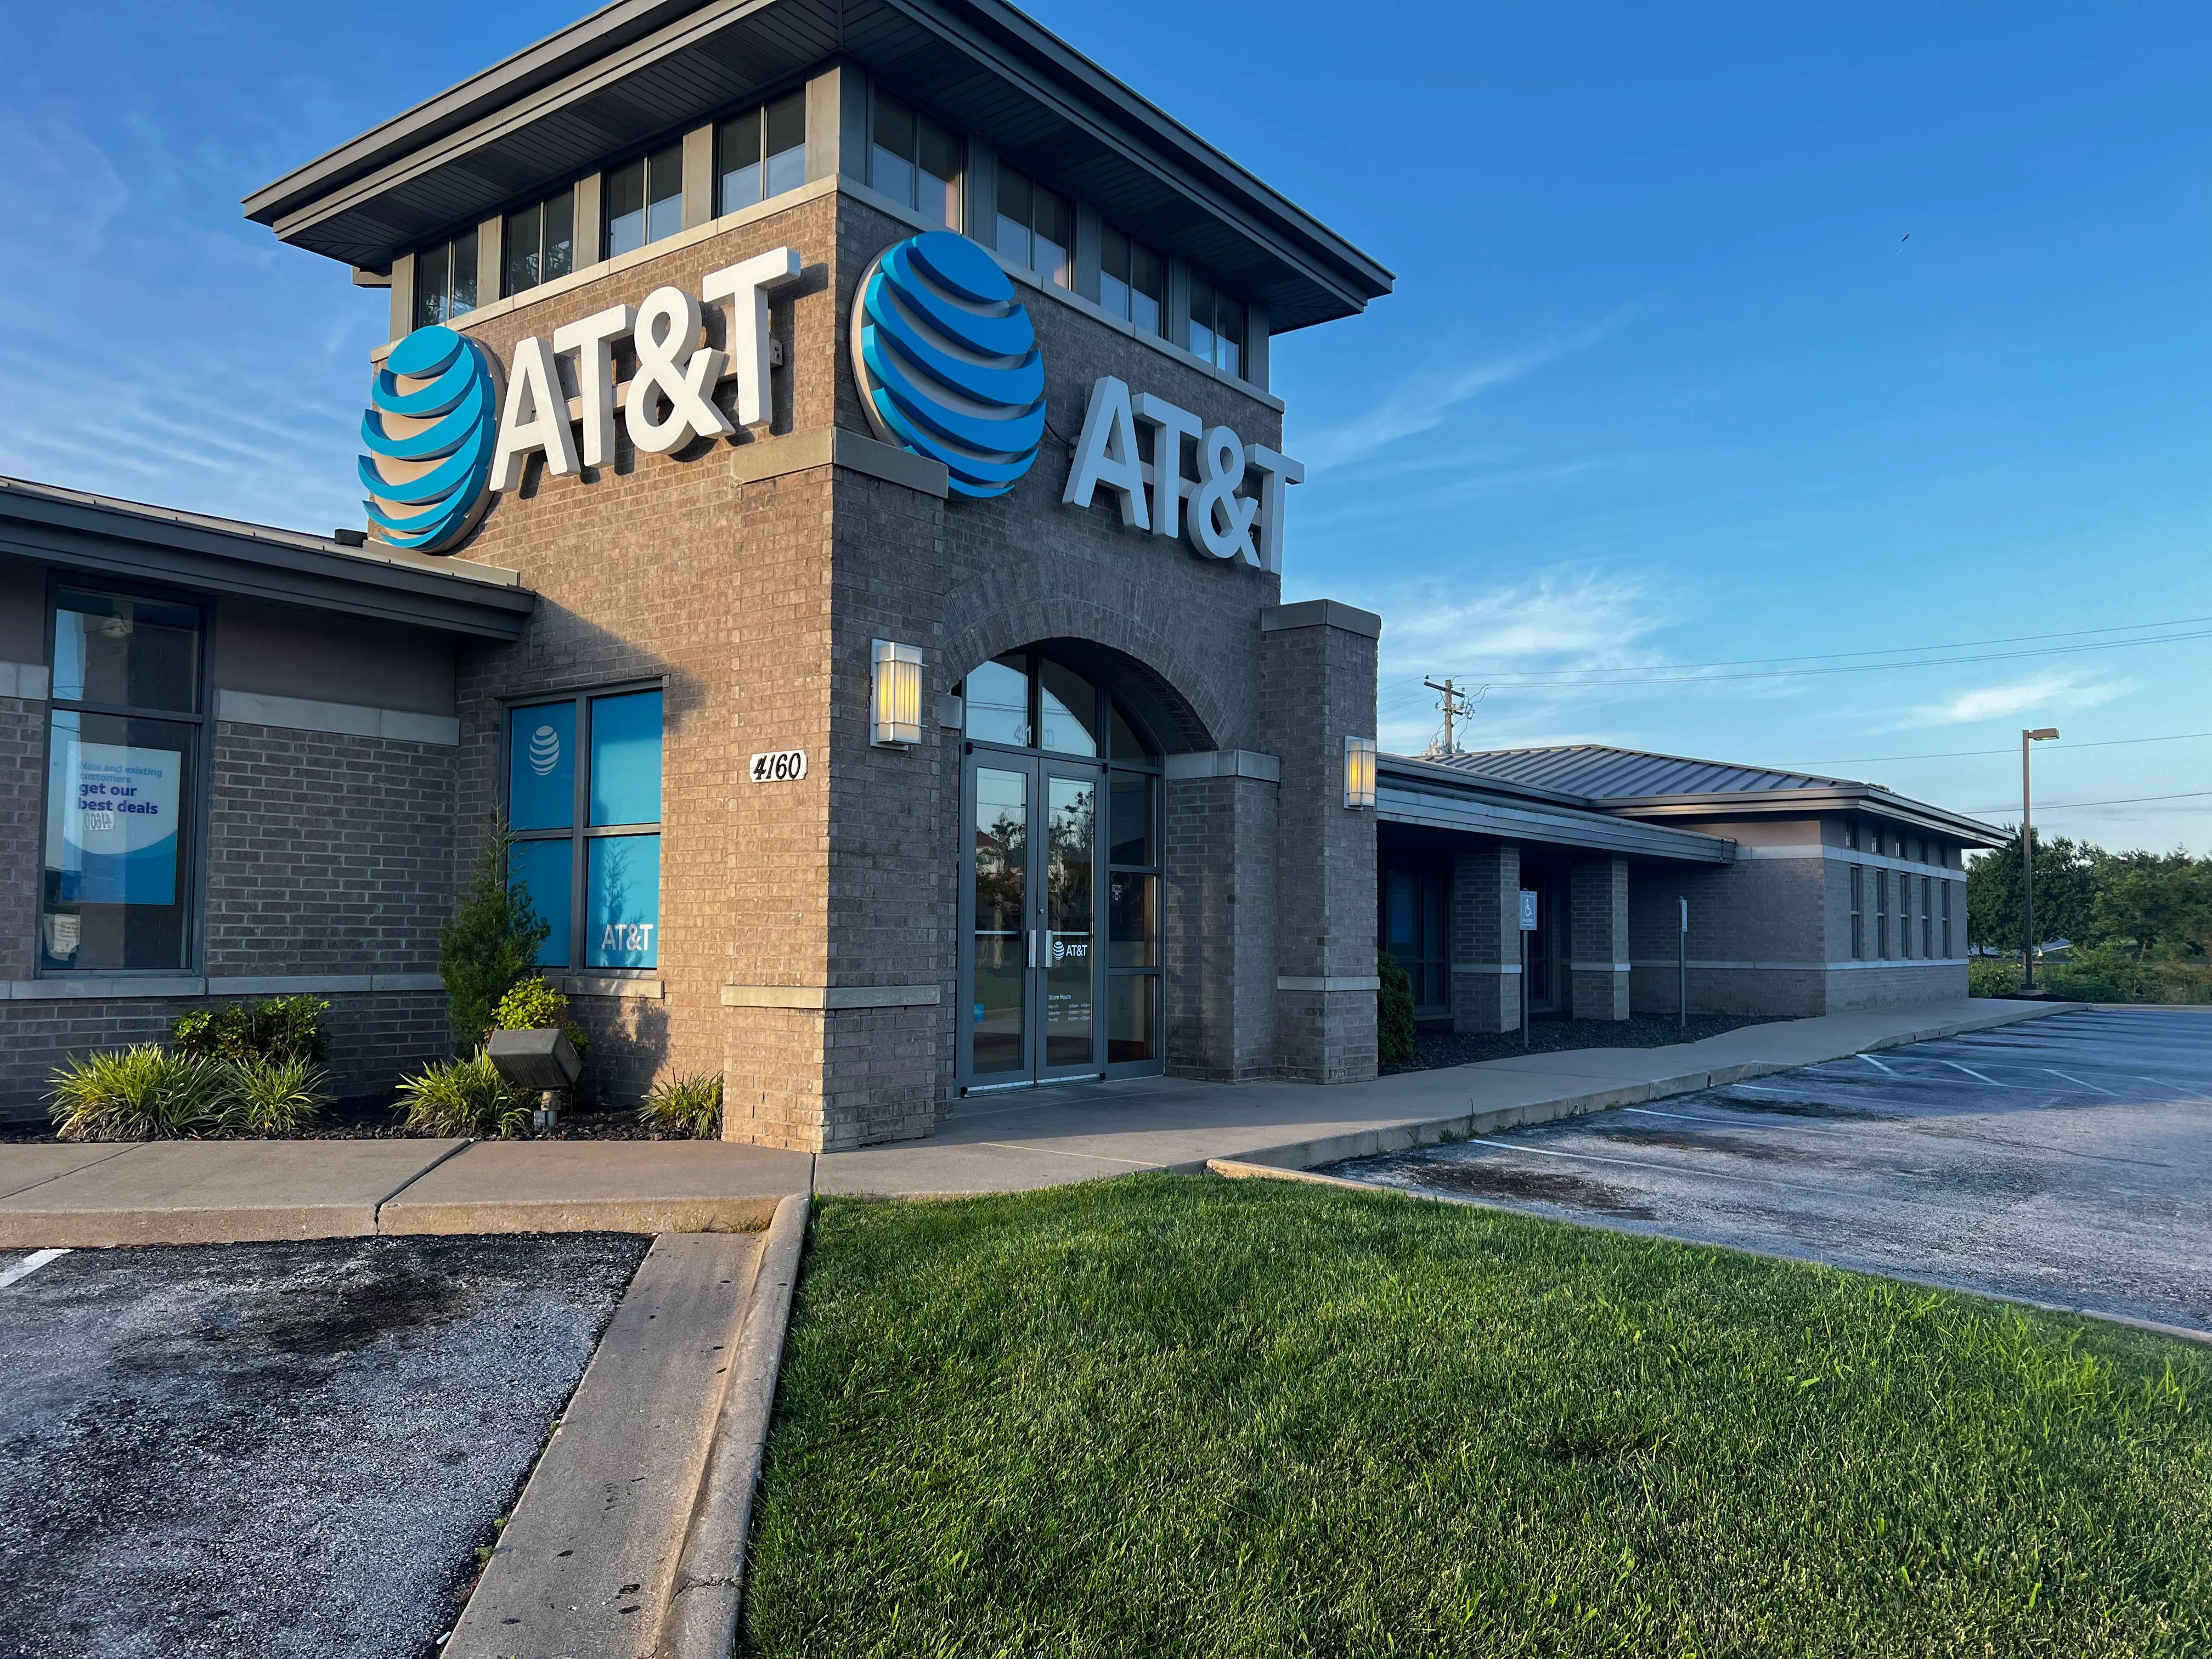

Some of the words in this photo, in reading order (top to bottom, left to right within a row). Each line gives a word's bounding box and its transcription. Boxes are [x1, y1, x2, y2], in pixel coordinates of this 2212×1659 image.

[489, 246, 800, 493] AT&T
[1063, 375, 1305, 575] AT&T
[81, 762, 101, 771] New
[104, 765, 122, 773] and
[125, 766, 162, 778] existing
[753, 753, 801, 780] 4160
[80, 772, 131, 783] customers
[79, 783, 106, 796] get
[110, 786, 137, 797] our
[78, 797, 113, 811] best
[117, 800, 158, 814] deals
[601, 924, 653, 951] AT&T
[1066, 944, 1088, 956] AT&T
